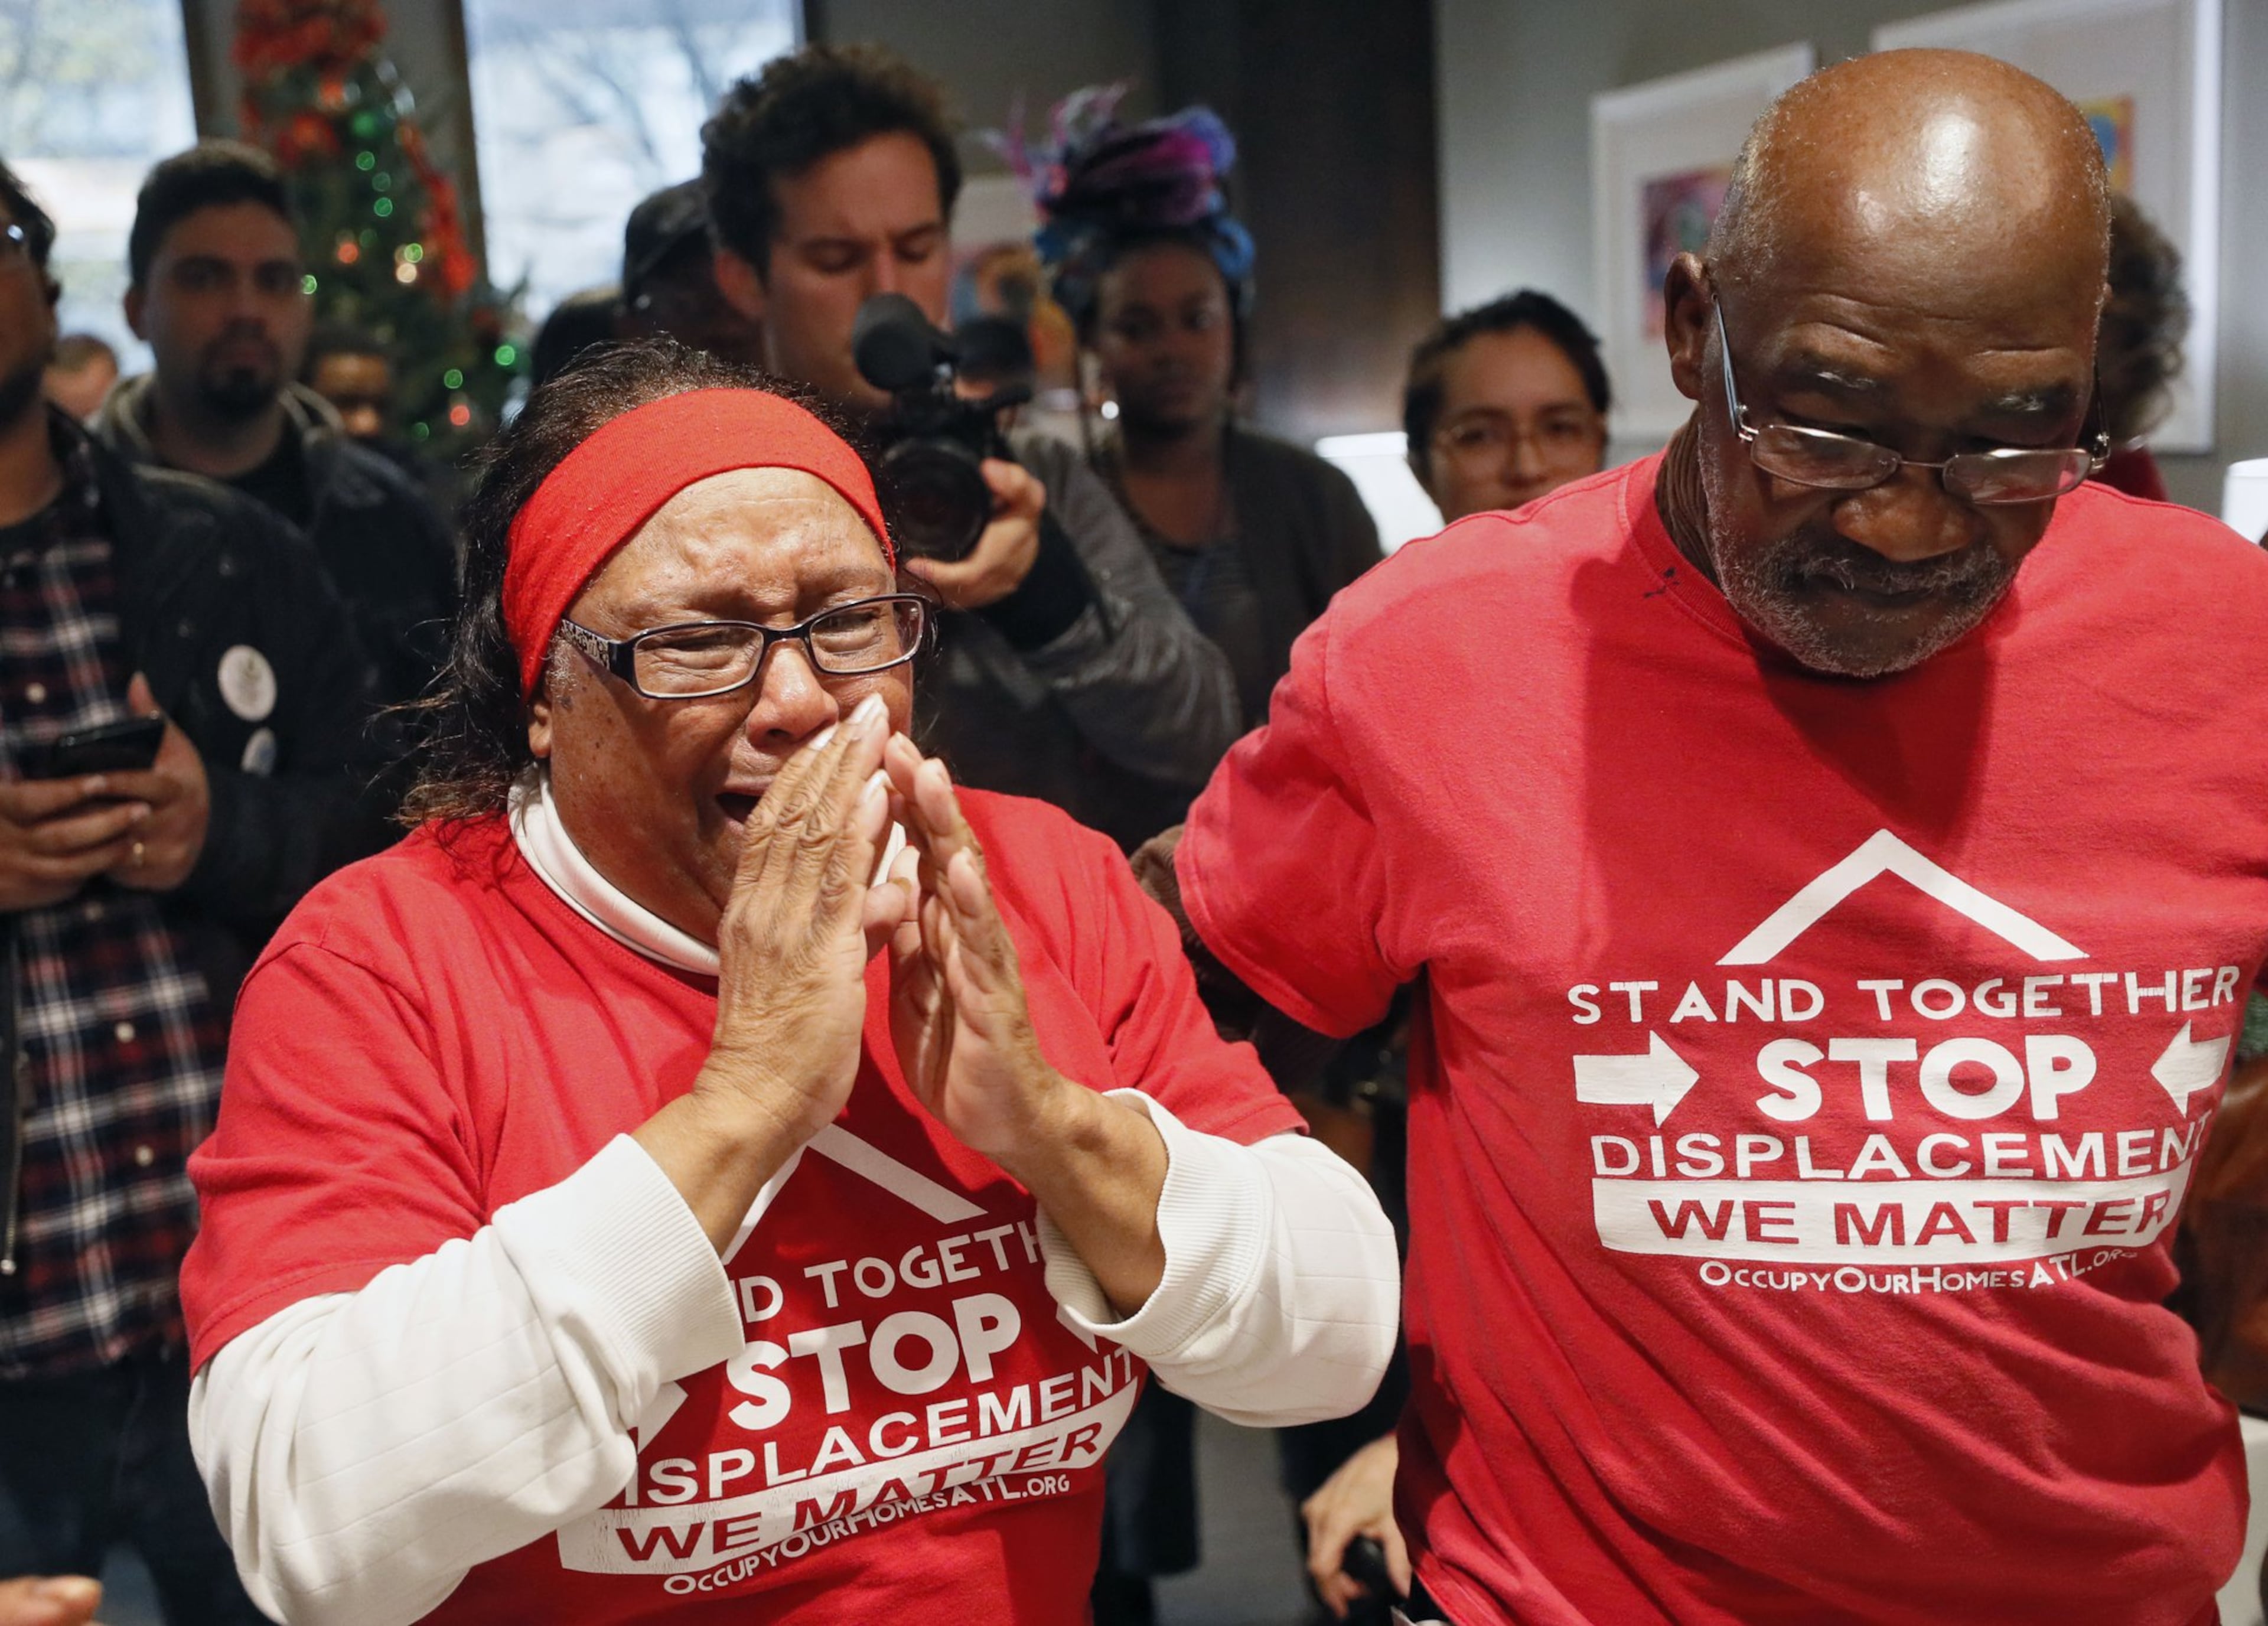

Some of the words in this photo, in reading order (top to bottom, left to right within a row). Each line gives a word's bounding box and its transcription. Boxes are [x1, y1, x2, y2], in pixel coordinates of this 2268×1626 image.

[1568, 979, 1824, 1024] STAND
[1858, 966, 2240, 1021] TOGETHER
[1756, 1035, 2097, 1121] STOP
[1591, 1109, 2212, 1179] DISPLACEMENT
[1647, 1199, 1800, 1244] WE
[1833, 1189, 2171, 1246] MATTER
[726, 1293, 1021, 1431] STOP
[616, 1512, 762, 1561] WE
